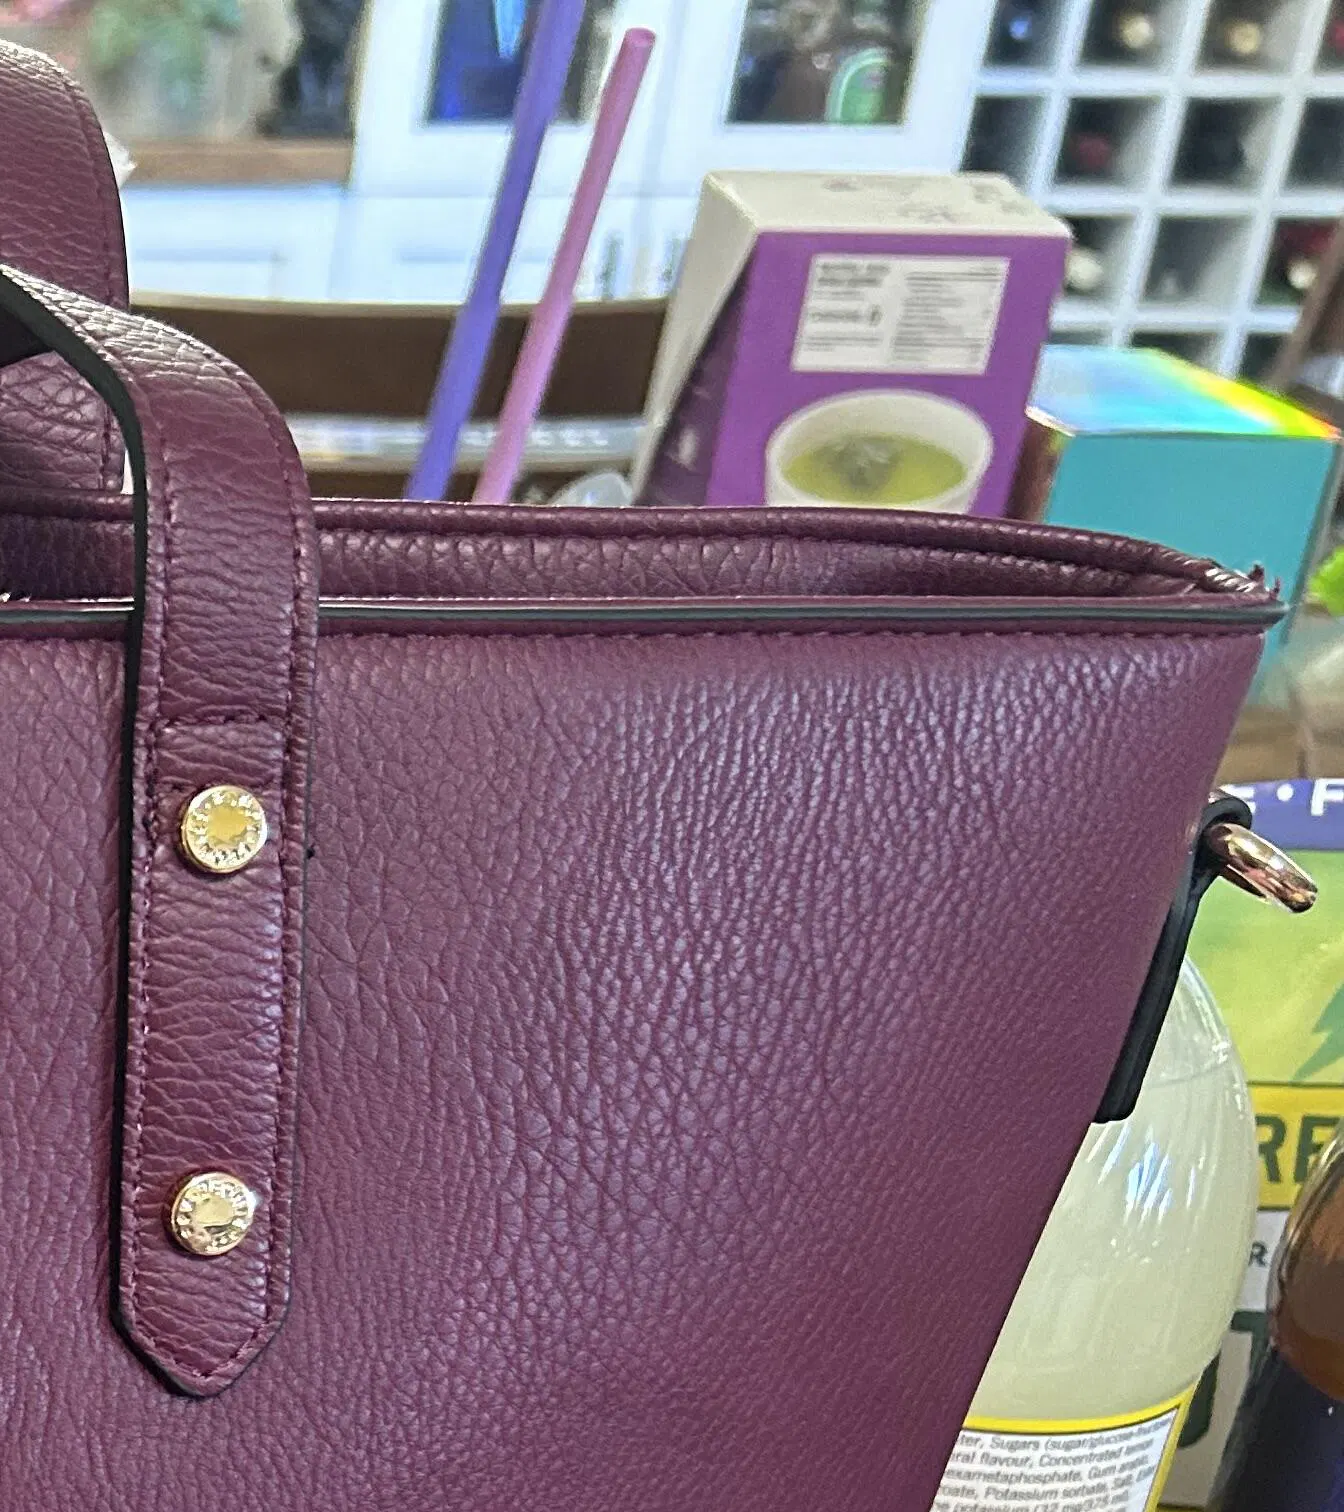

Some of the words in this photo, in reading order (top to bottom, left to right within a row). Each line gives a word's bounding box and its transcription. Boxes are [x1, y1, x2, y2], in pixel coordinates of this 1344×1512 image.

[989, 1436, 1040, 1452] Sugars
[1038, 1446, 1123, 1468] Concentrated
[983, 1485, 1059, 1501] Potassium
